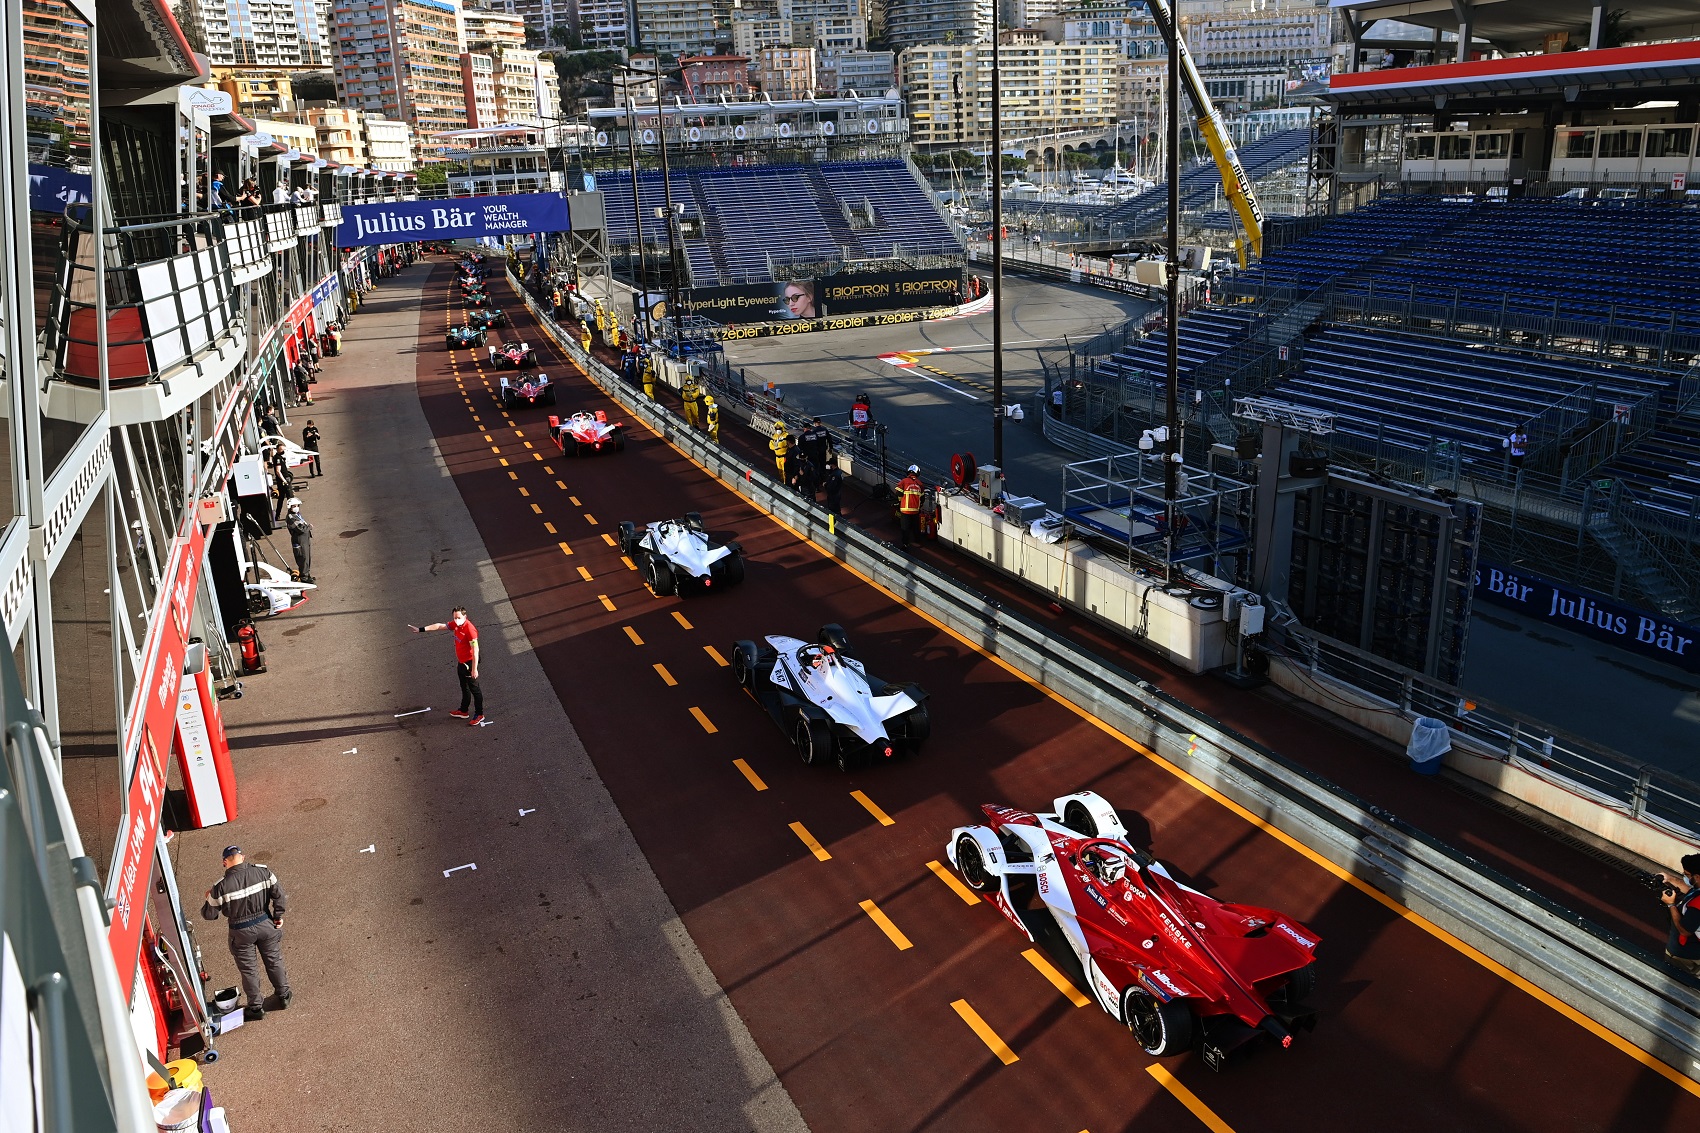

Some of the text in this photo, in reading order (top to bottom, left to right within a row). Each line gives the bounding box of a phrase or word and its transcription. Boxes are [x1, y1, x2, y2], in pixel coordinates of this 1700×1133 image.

[482, 204, 508, 214] YOUR
[484, 212, 519, 222] WEALTH
[354, 207, 476, 240] Julius Bär
[485, 220, 528, 230] MANAGER
[832, 284, 890, 297] BIOPTRON
[902, 279, 958, 292] BIOPTRON
[683, 296, 778, 311] HyperLight Eyewear
[830, 316, 868, 330] zepter
[880, 312, 918, 325] zepter
[777, 322, 817, 335] zepter
[1488, 568, 1533, 603] Bär
[1548, 588, 1627, 636] Julius
[1635, 615, 1693, 656] Bär
[138, 743, 160, 830] 94
[123, 809, 147, 902] Alex LYNN
[1038, 872, 1050, 894] BOSCH
[1128, 884, 1147, 900] BOSCH
[1086, 885, 1106, 907] Julius Bär
[1160, 912, 1192, 950] PENSKE
[1276, 924, 1316, 948] billboard
[1100, 980, 1118, 1003] BOSCH
[1152, 970, 1190, 996] billboard
